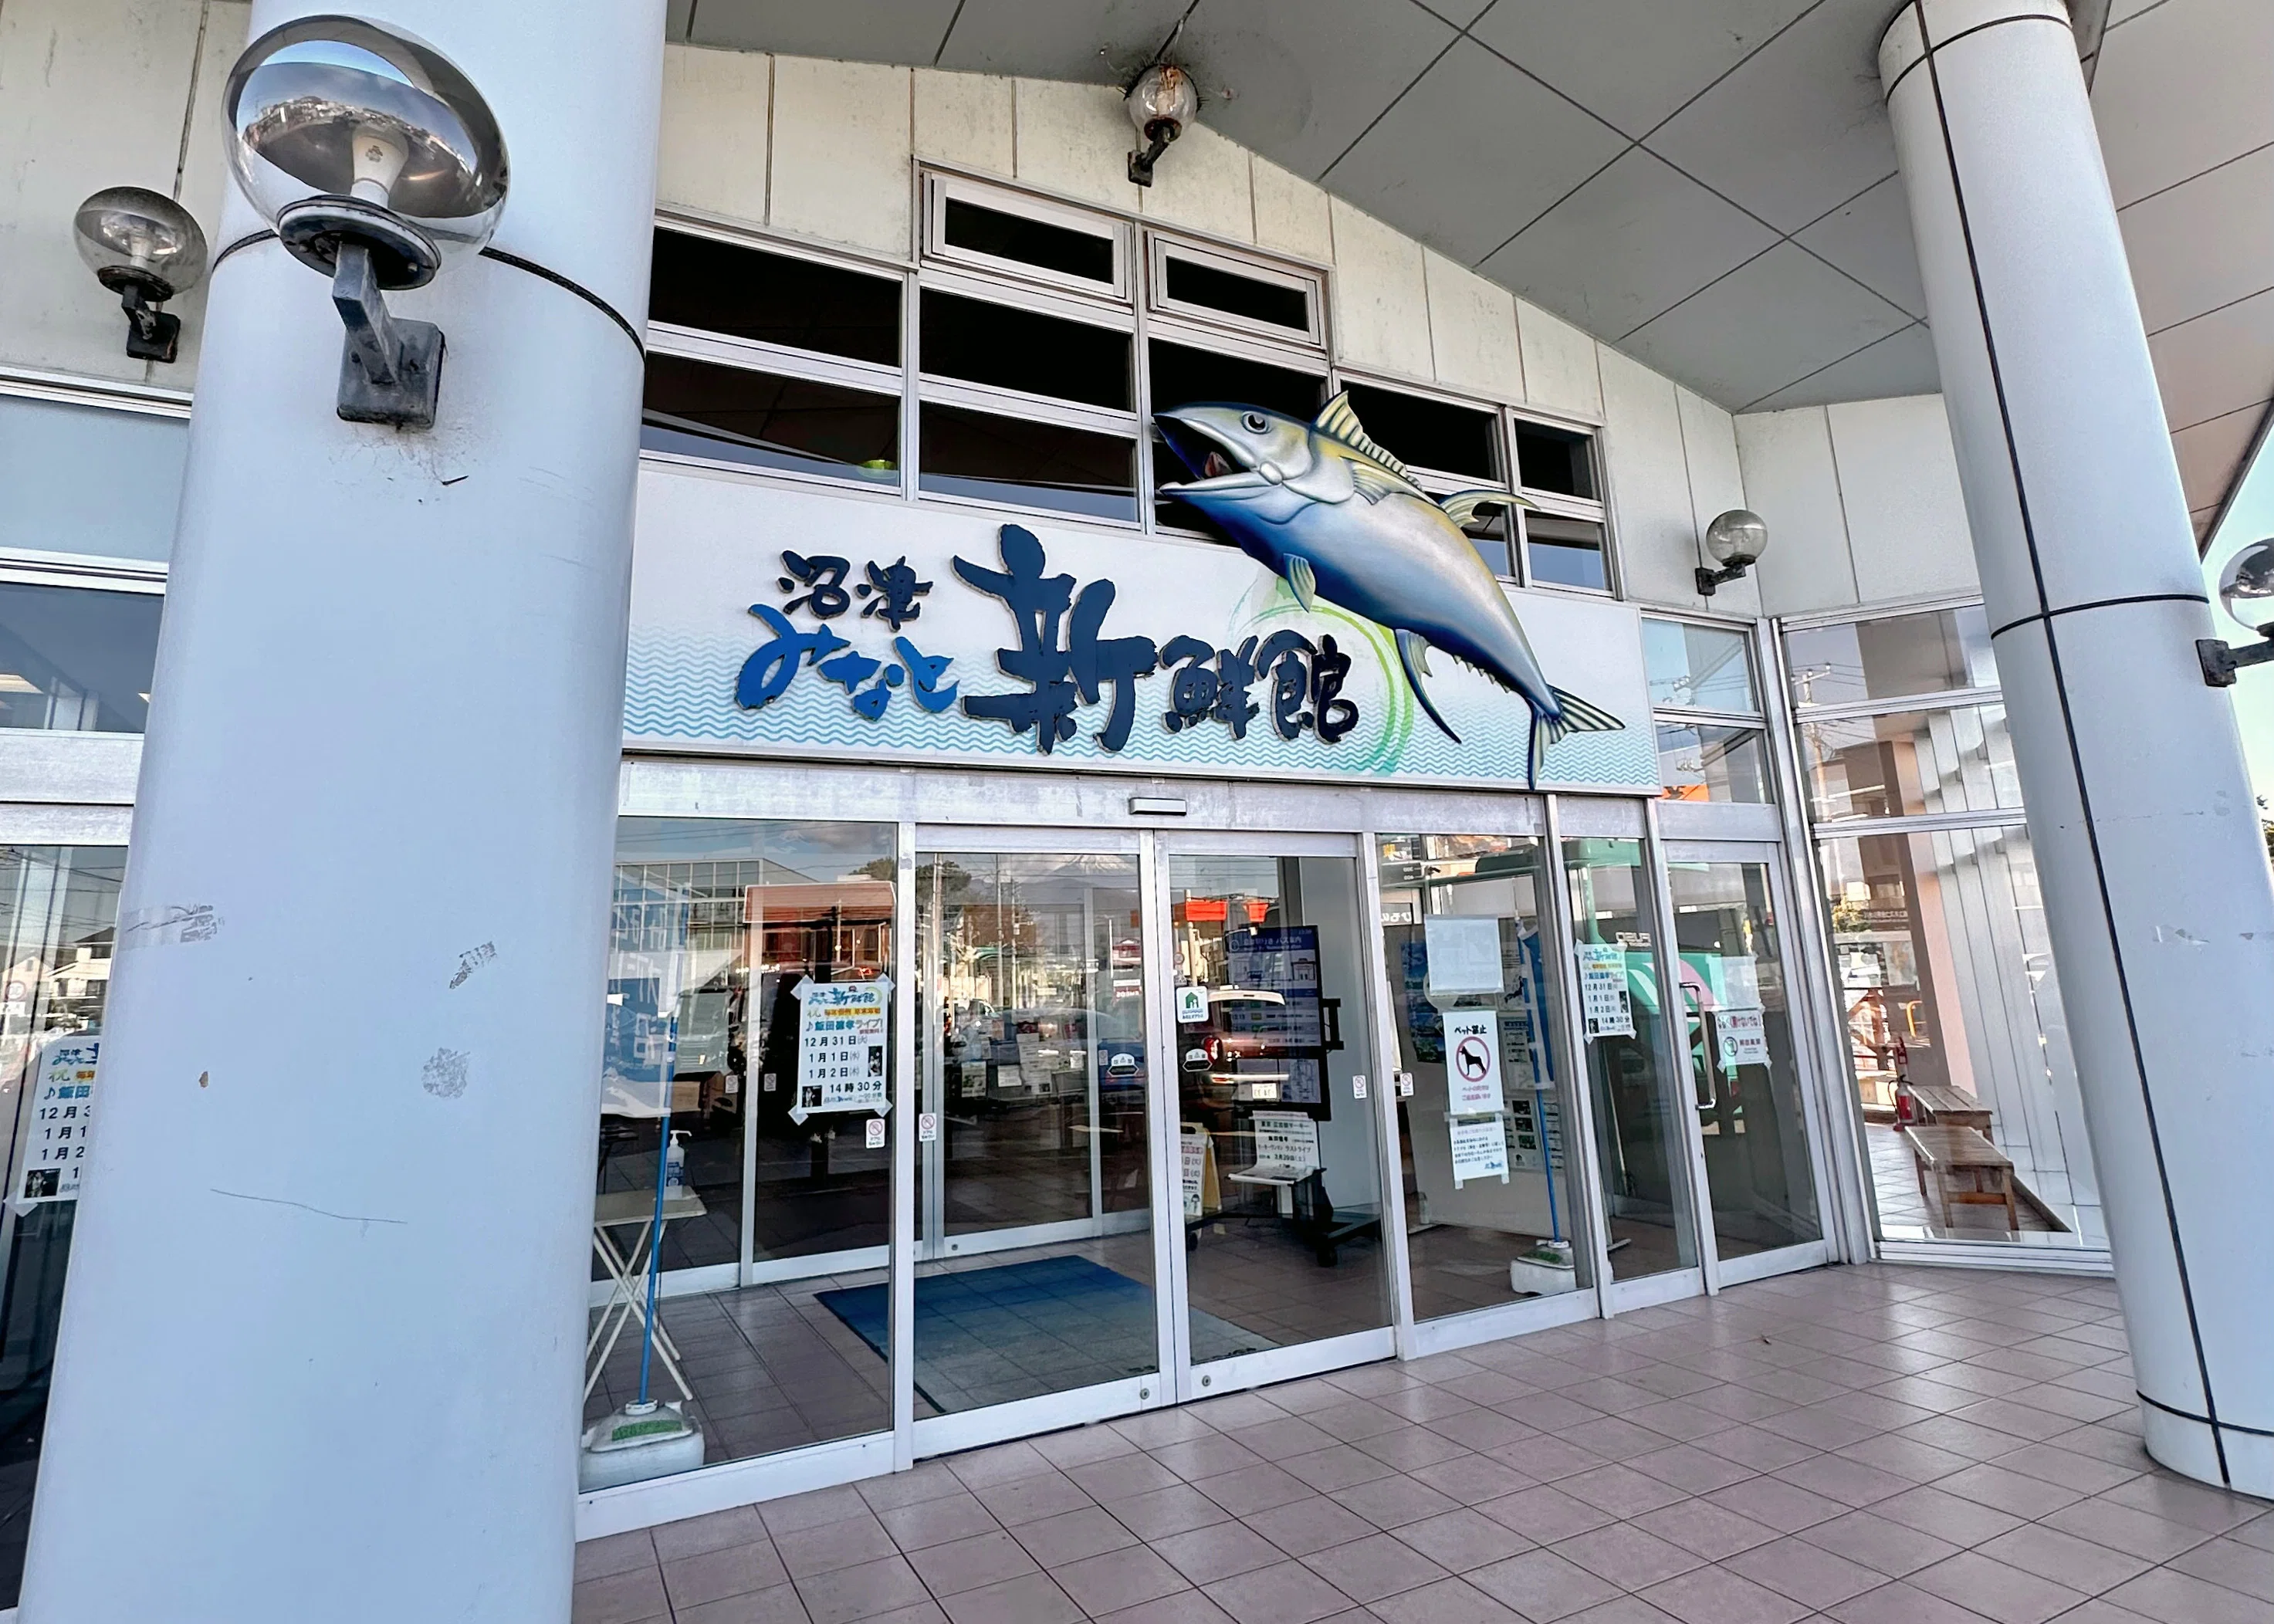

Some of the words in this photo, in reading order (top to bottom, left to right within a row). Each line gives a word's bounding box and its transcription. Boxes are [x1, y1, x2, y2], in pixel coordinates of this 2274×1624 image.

[777, 550, 933, 632] 沼津
[950, 523, 1359, 756] 新鮮館
[734, 603, 960, 722] みなと
